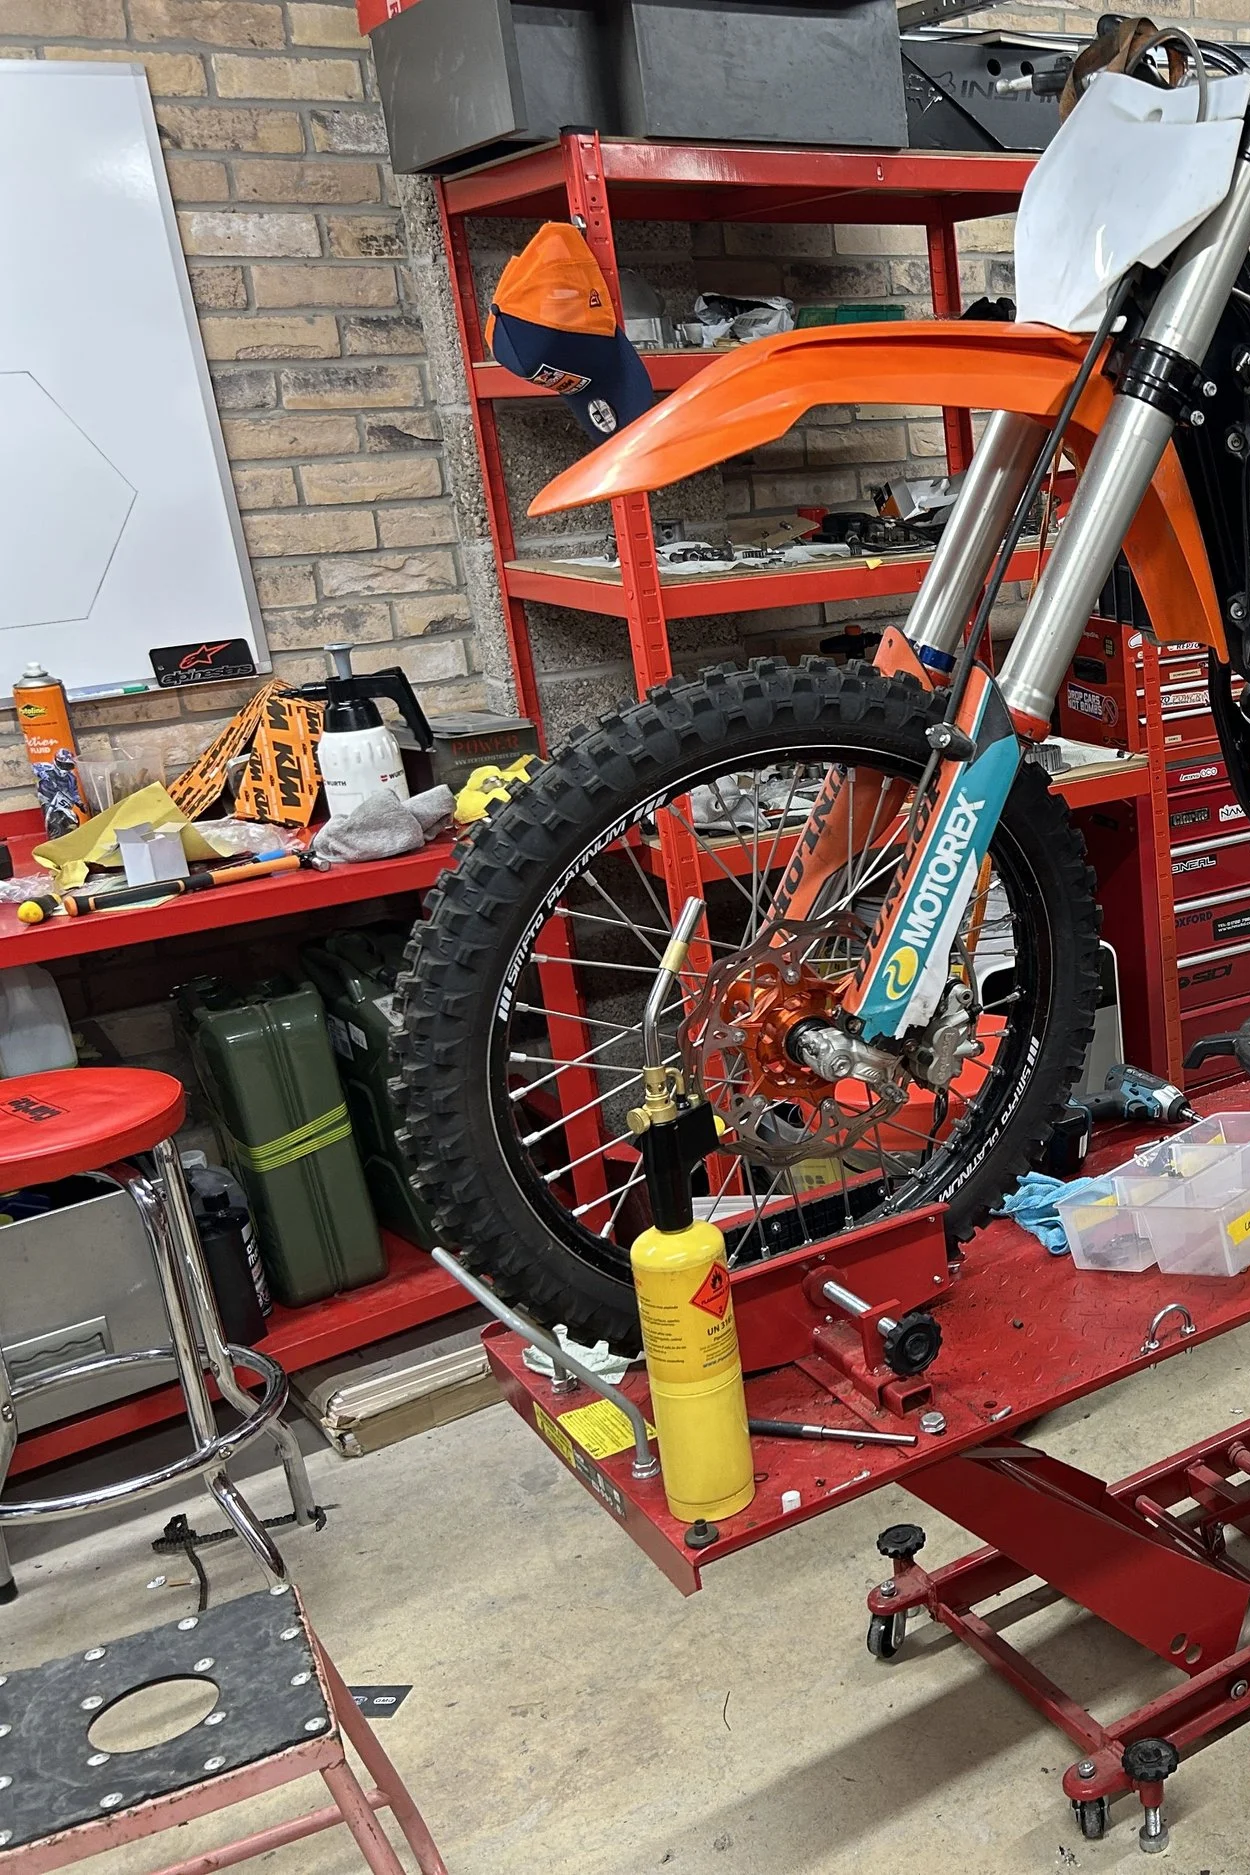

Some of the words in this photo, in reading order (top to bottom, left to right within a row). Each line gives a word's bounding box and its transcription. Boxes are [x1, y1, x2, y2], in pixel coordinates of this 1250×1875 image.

[1067, 700, 1081, 710] NOT
[1080, 701, 1103, 716] BOMBS
[1083, 692, 1101, 705] CARS
[452, 734, 519, 756] POWER
[250, 747, 264, 782] KTM
[272, 741, 305, 808] KTM
[547, 819, 627, 909] PLATINUM
[902, 791, 985, 949] MOTOREX
[938, 1127, 1000, 1203] PLATINUM
[707, 1325, 720, 1336] UN
